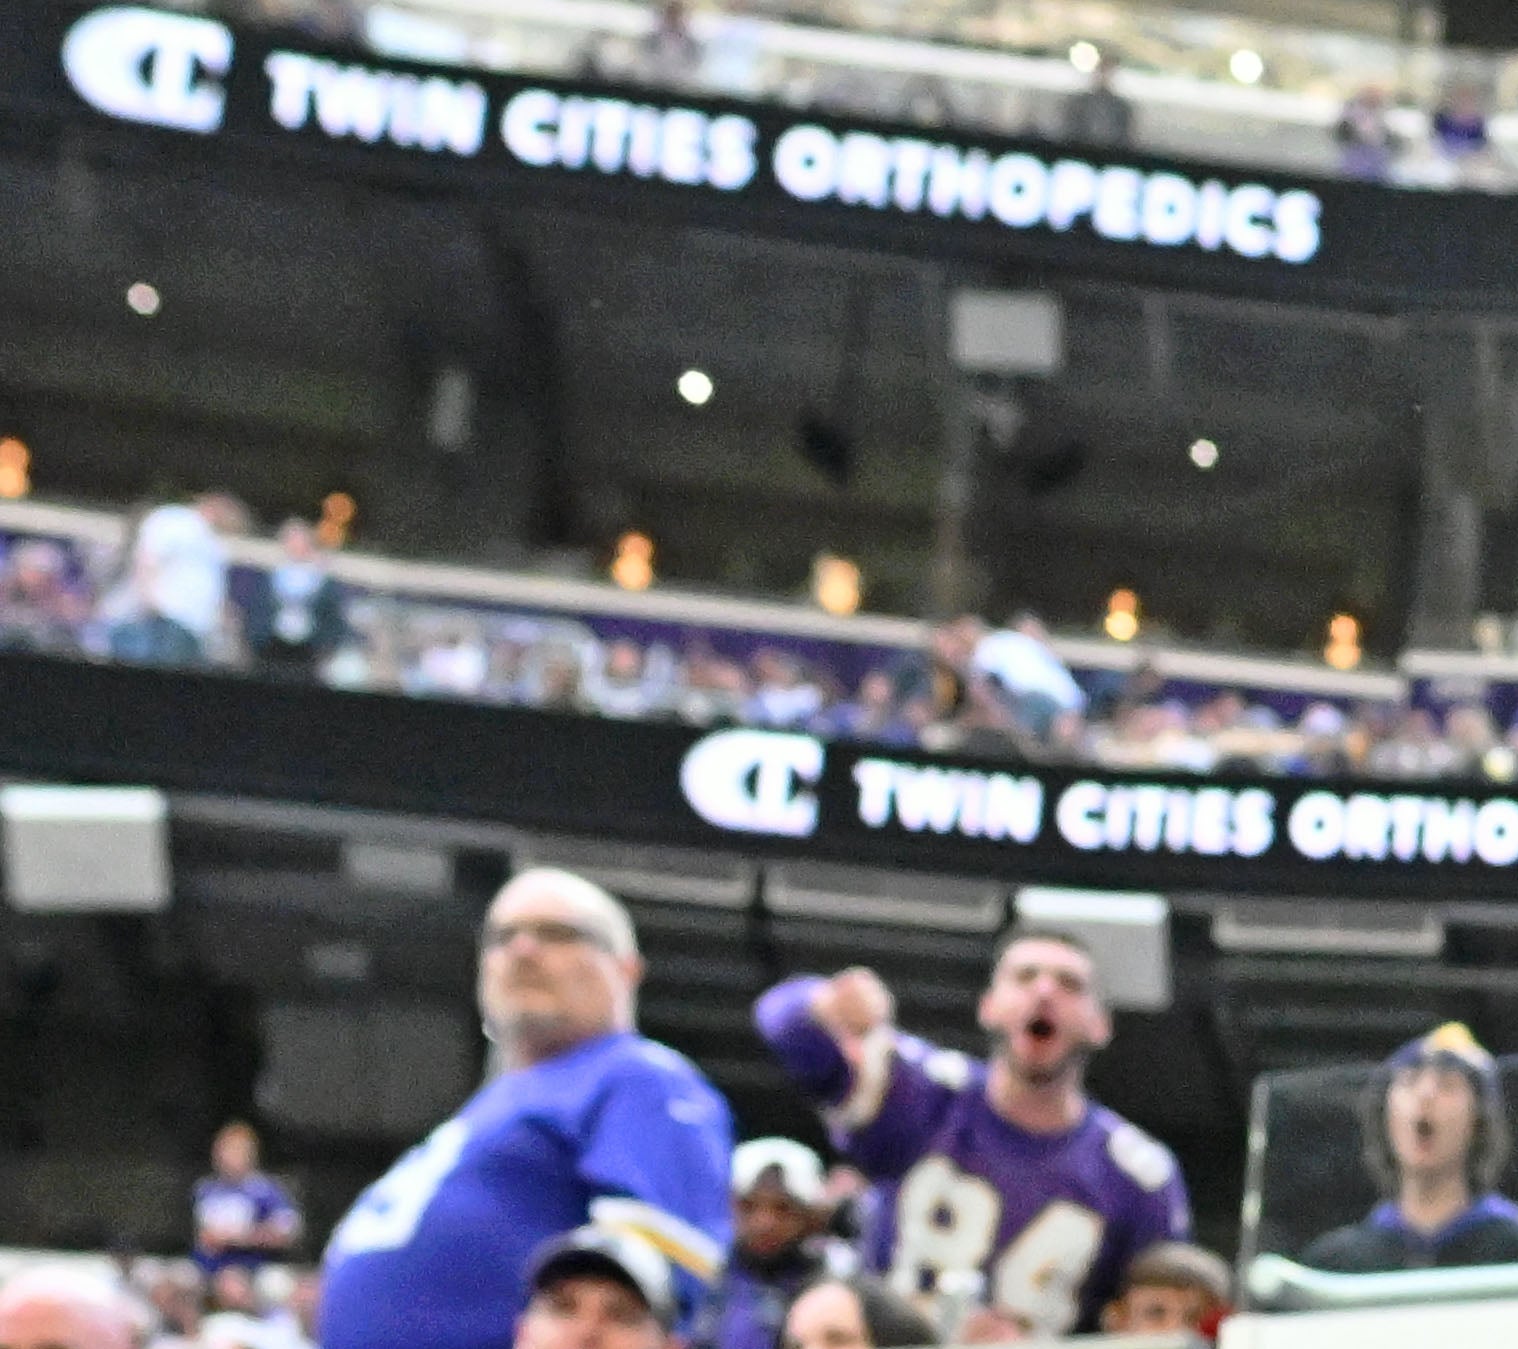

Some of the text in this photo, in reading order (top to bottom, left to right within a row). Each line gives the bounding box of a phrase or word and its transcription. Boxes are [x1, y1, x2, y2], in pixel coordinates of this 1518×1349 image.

[266, 51, 486, 155] TWIN
[501, 90, 756, 189] CITIES
[773, 125, 1320, 262] ORTHOPEDICS
[853, 759, 1043, 842] TWIN
[1056, 782, 1274, 856] CITIES
